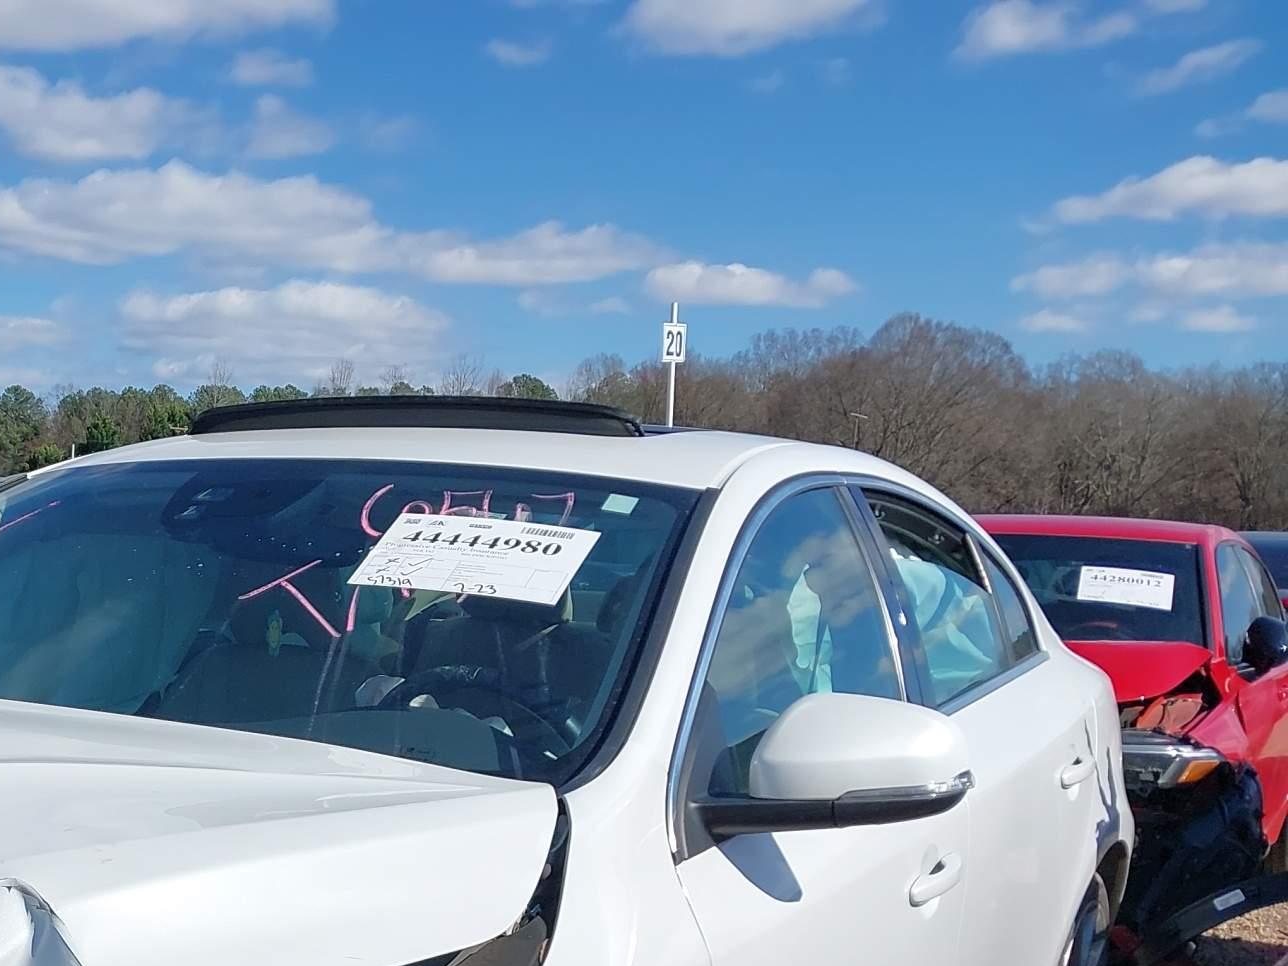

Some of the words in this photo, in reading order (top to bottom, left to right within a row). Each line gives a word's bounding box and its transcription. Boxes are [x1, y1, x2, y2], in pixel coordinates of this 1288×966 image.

[666, 330, 683, 357] 20
[402, 530, 562, 556] 44444980
[1090, 573, 1161, 588] 44280012
